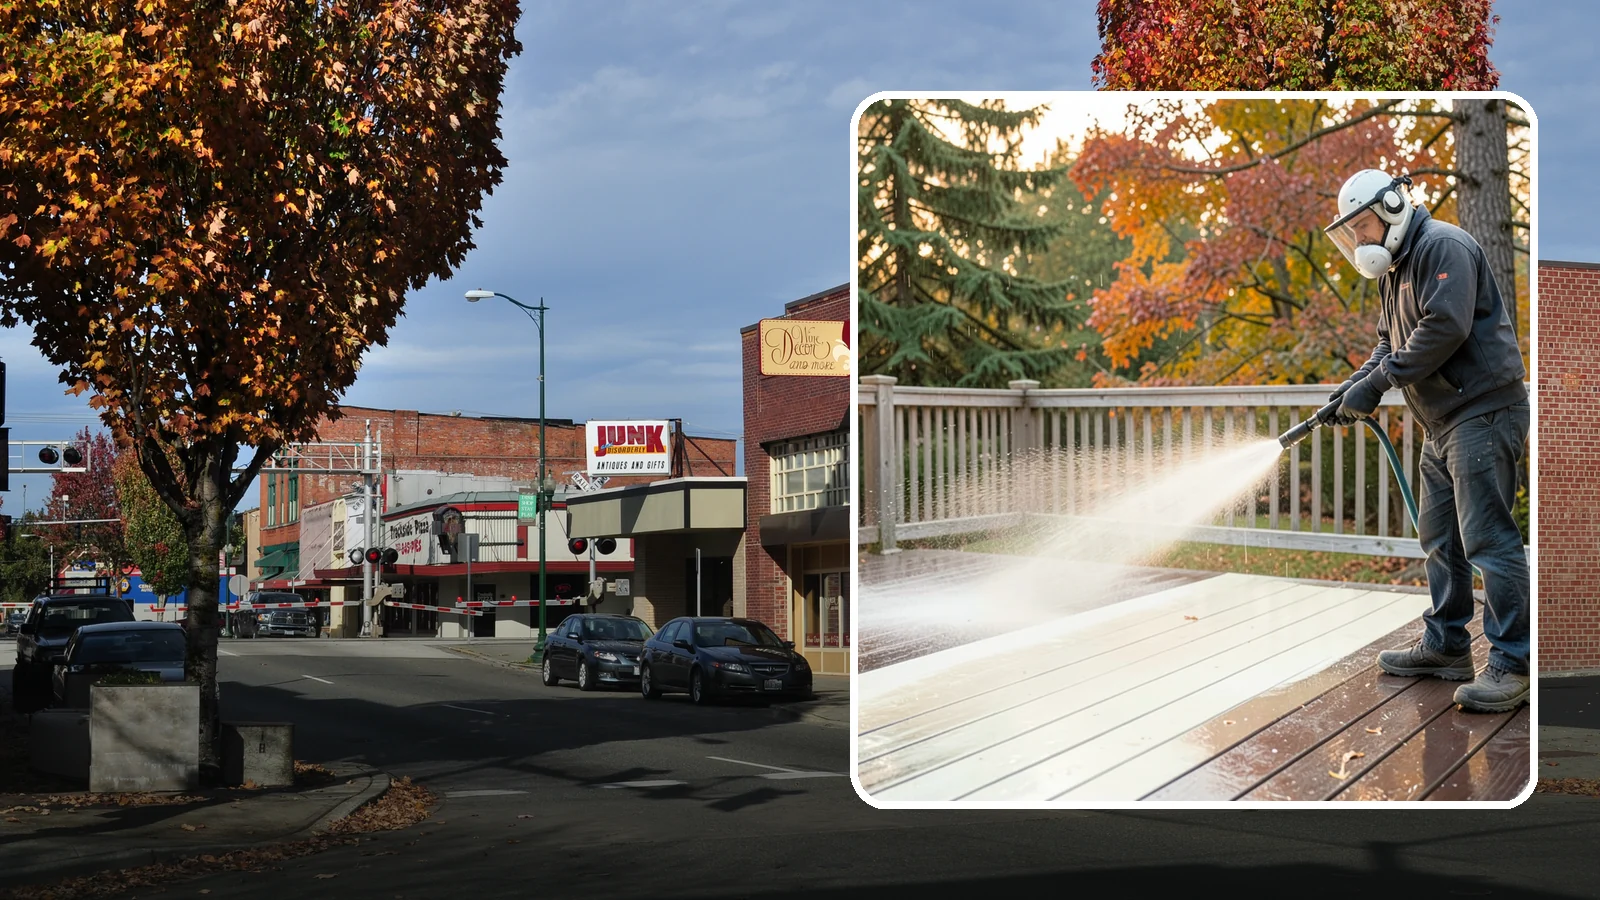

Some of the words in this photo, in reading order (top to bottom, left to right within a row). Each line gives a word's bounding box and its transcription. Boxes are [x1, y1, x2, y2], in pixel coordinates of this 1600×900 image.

[595, 425, 665, 457] JUNK
[607, 446, 646, 454] DISORDERLY
[597, 461, 628, 470] ANTIQUES
[631, 461, 644, 470] AND
[647, 460, 665, 469] GIFTS
[414, 519, 429, 535] Pizza
